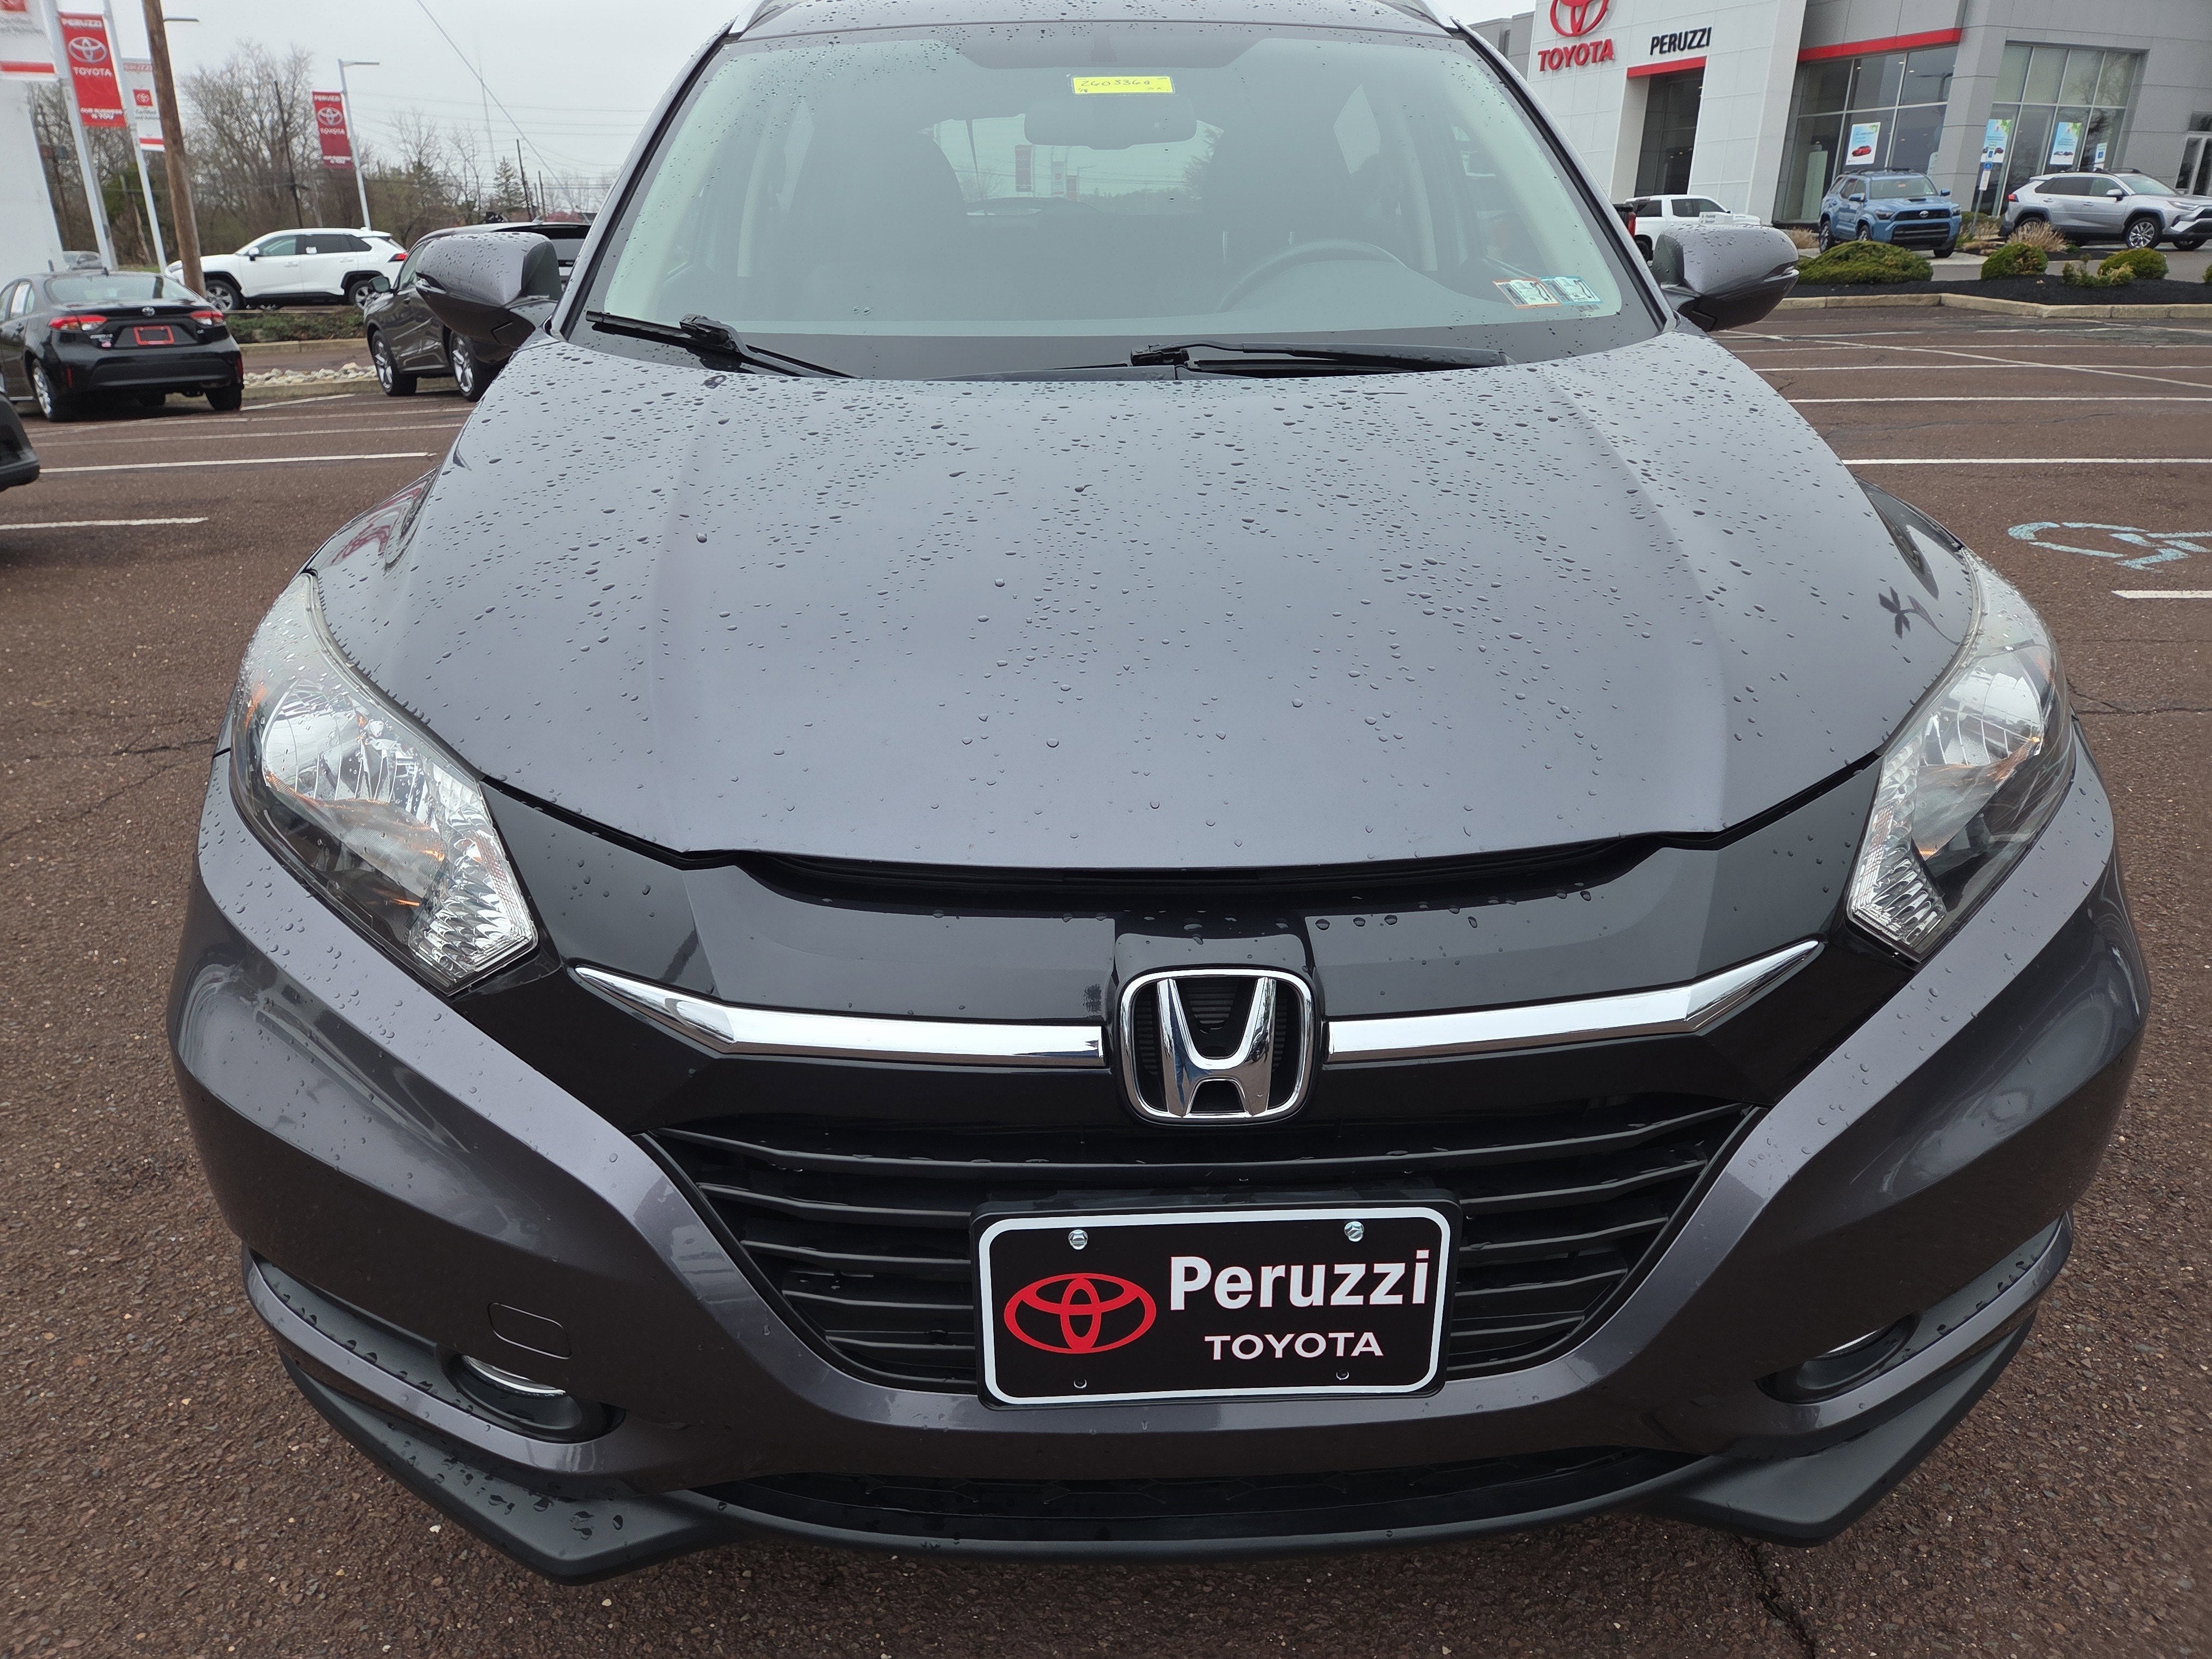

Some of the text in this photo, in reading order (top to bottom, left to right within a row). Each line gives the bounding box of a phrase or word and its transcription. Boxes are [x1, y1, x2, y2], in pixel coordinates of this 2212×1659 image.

[1538, 38, 1614, 72] TOYOTA
[1650, 27, 1712, 55] PERUZZI
[73, 67, 113, 77] TOYOTA
[1170, 1249, 1430, 1311] Peruzzi
[1204, 1332, 1384, 1361] TOYOTA
